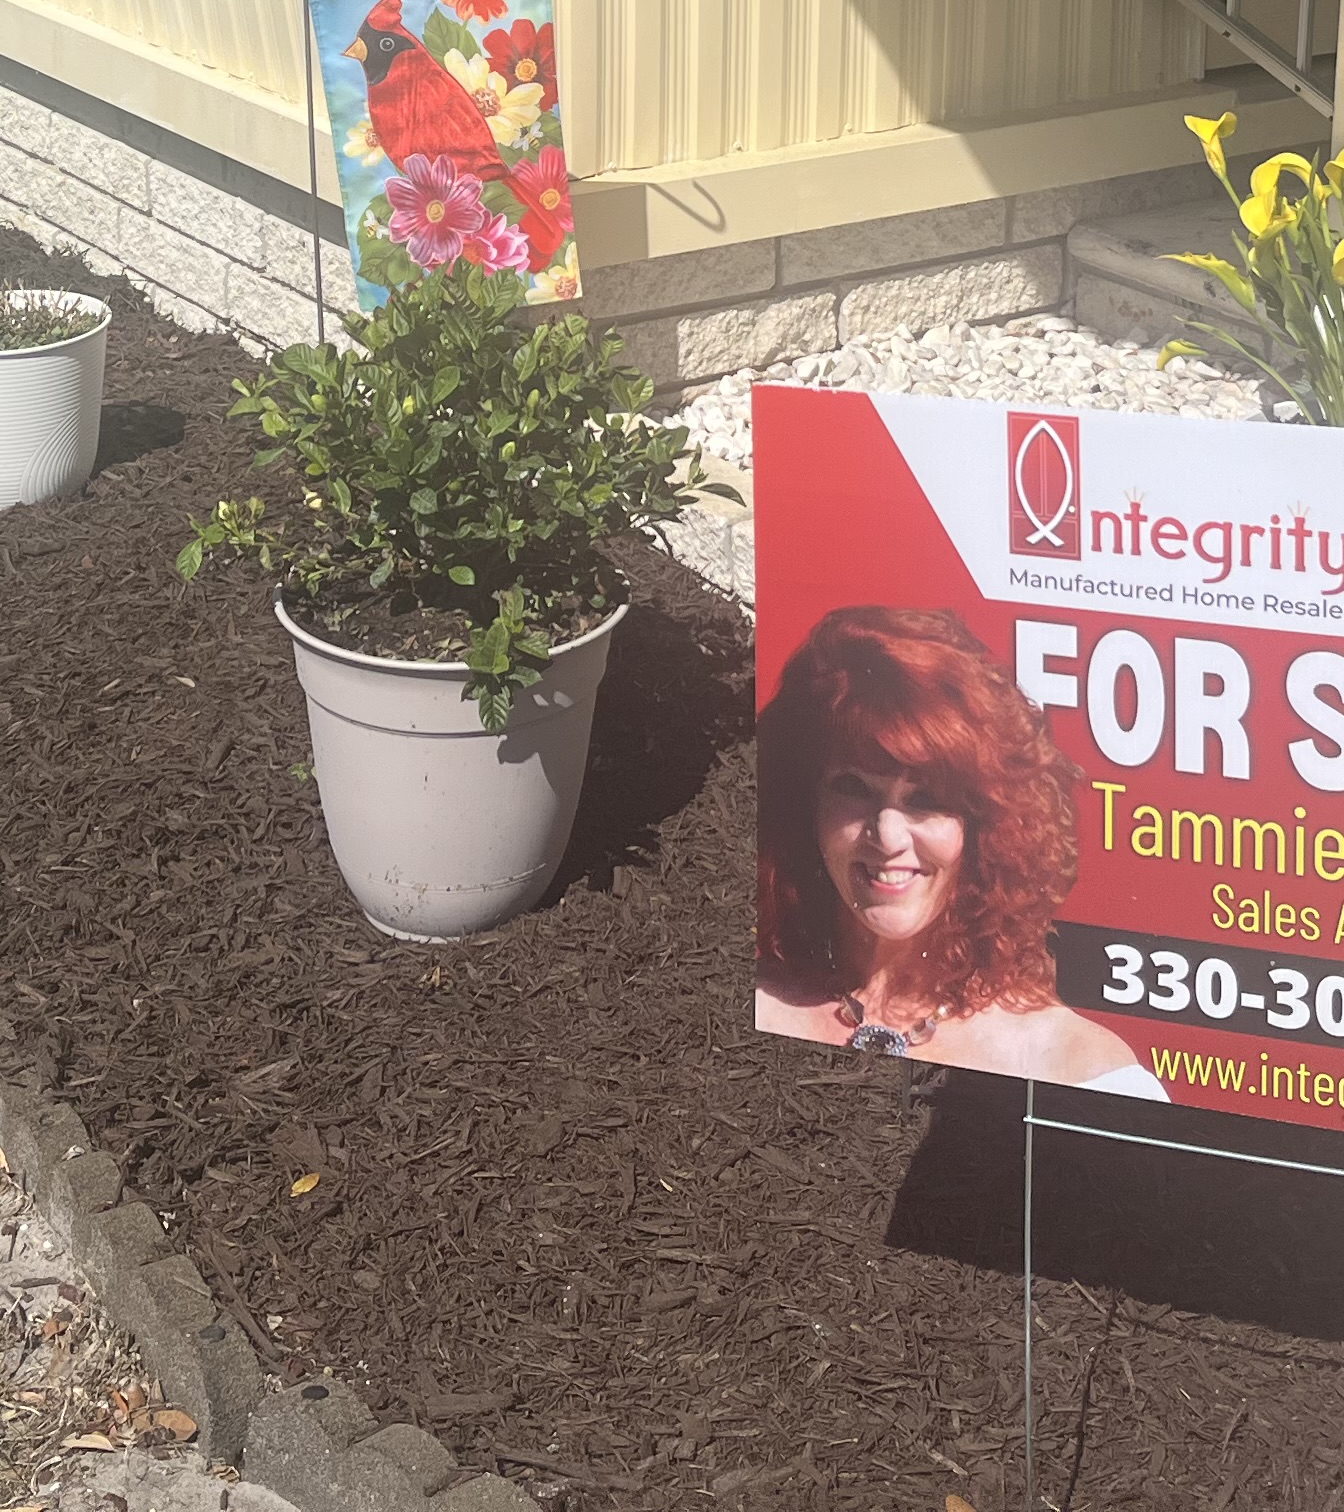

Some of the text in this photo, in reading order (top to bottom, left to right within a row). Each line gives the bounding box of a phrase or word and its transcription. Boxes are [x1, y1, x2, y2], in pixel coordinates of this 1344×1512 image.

[1009, 567, 1174, 603] Manufactured
[1181, 585, 1255, 611] Home
[1015, 619, 1251, 781] FOR
[1211, 883, 1321, 942] Sales
